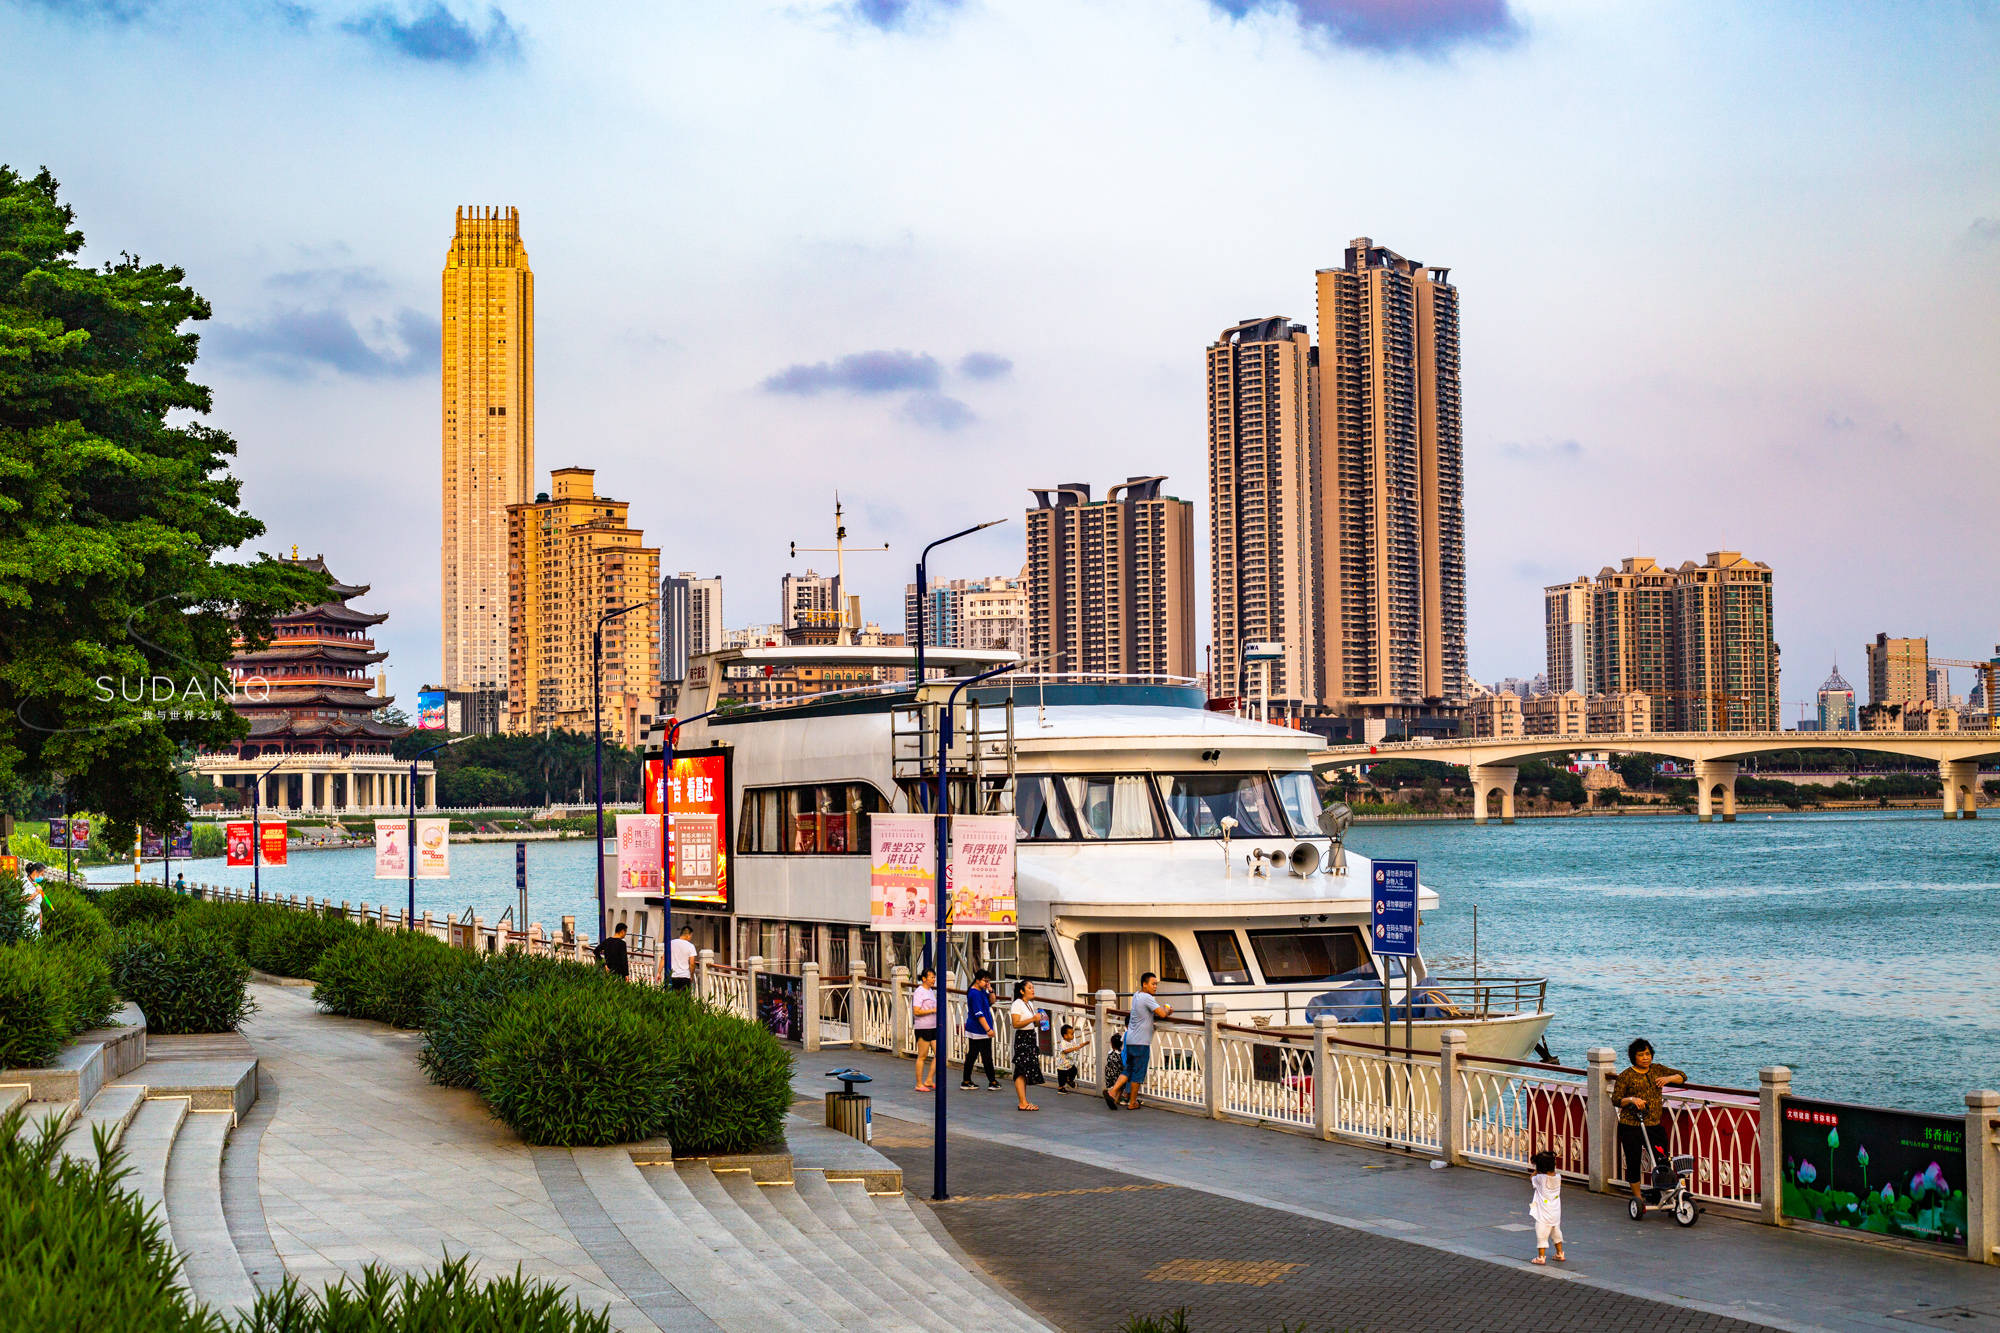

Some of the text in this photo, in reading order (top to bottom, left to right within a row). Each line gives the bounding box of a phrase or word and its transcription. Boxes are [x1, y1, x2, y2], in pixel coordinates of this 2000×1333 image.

[880, 842, 926, 853] 乘坐公交
[961, 843, 1008, 855] 有序排队
[886, 853, 920, 864] 讲礼让
[967, 855, 1002, 866] 讲礼让
